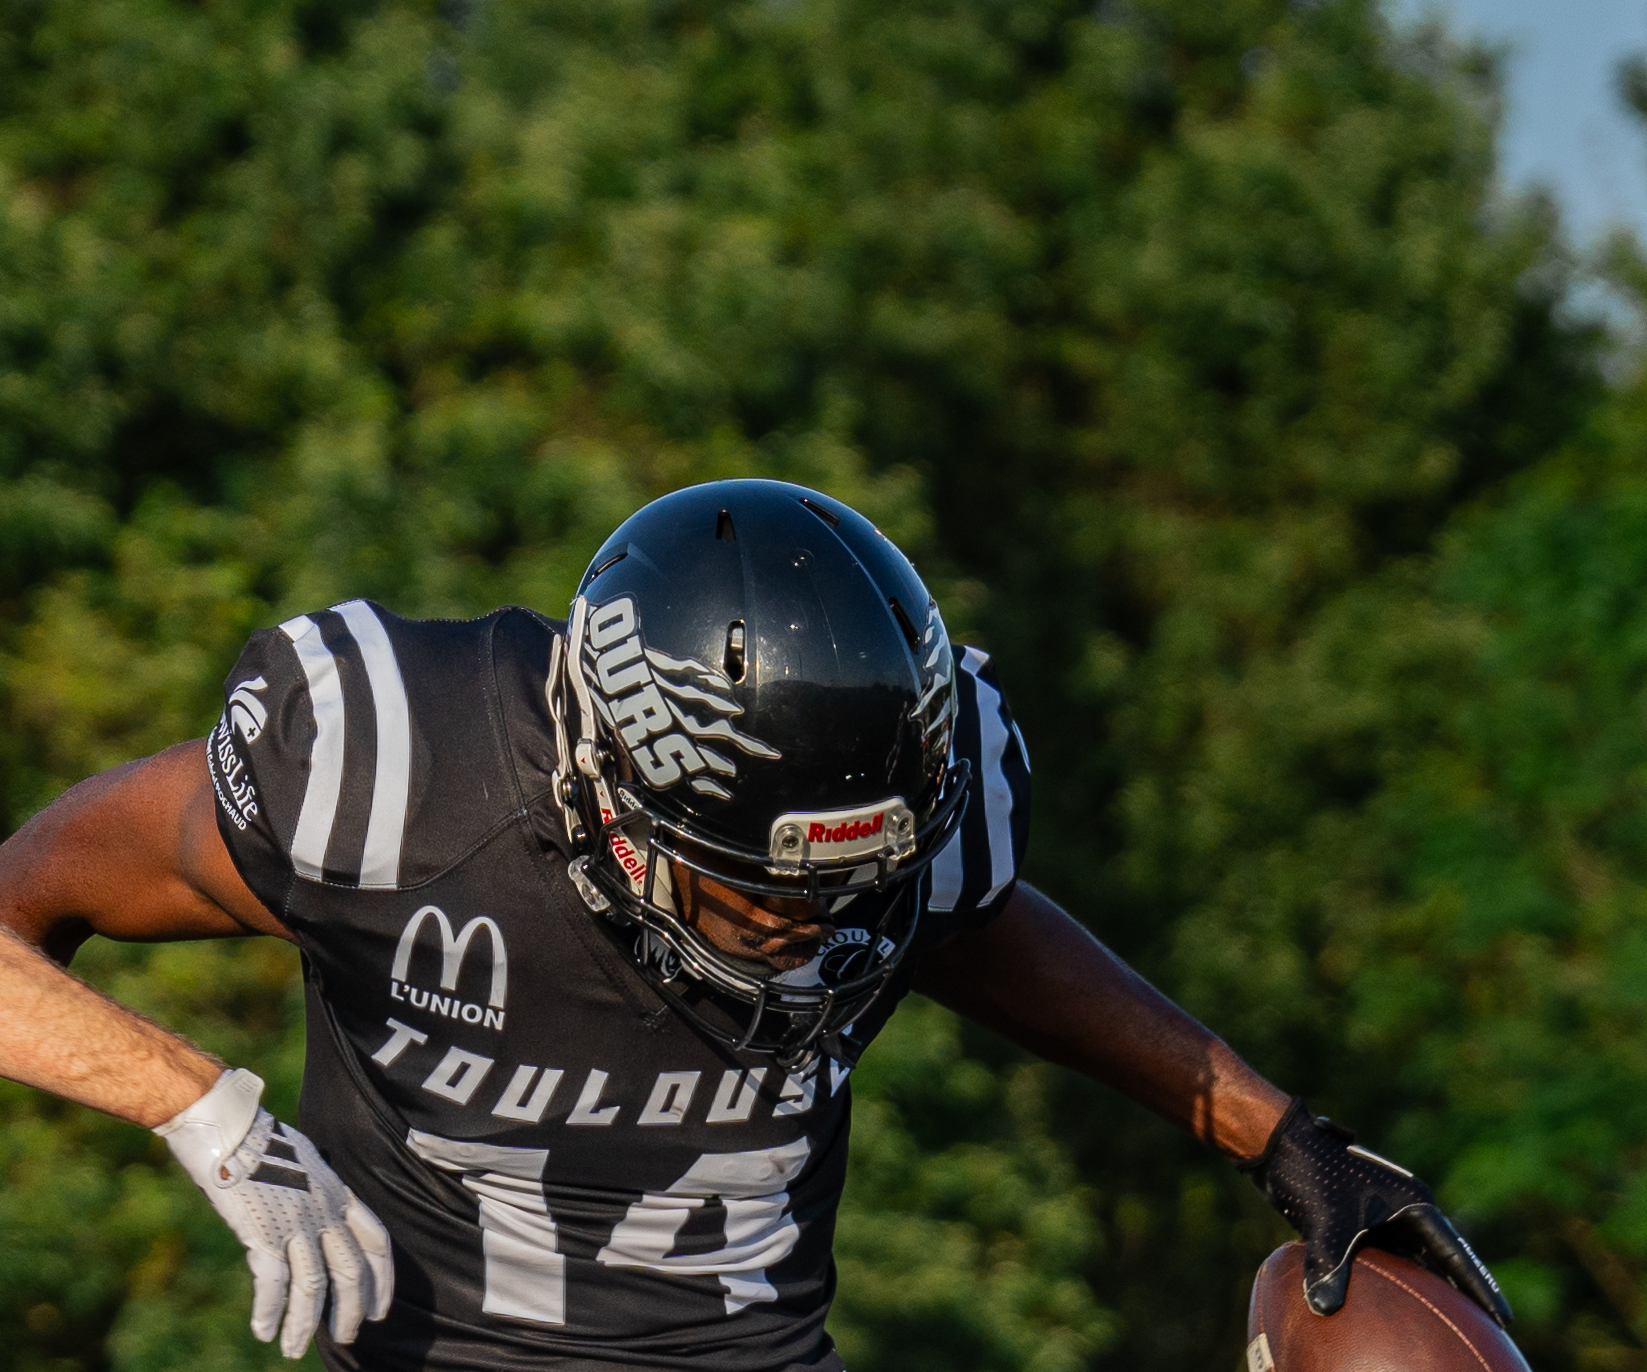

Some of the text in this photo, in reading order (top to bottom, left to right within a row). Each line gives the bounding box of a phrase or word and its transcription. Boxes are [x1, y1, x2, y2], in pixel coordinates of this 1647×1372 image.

[589, 597, 707, 790] OURS
[217, 709, 258, 822] wissLife
[601, 808, 646, 881] Rddell
[807, 811, 885, 843] Riddell
[391, 981, 506, 1030] L'UNION
[371, 1017, 819, 1126] TOULOUS
[406, 1128, 812, 1325] 14
